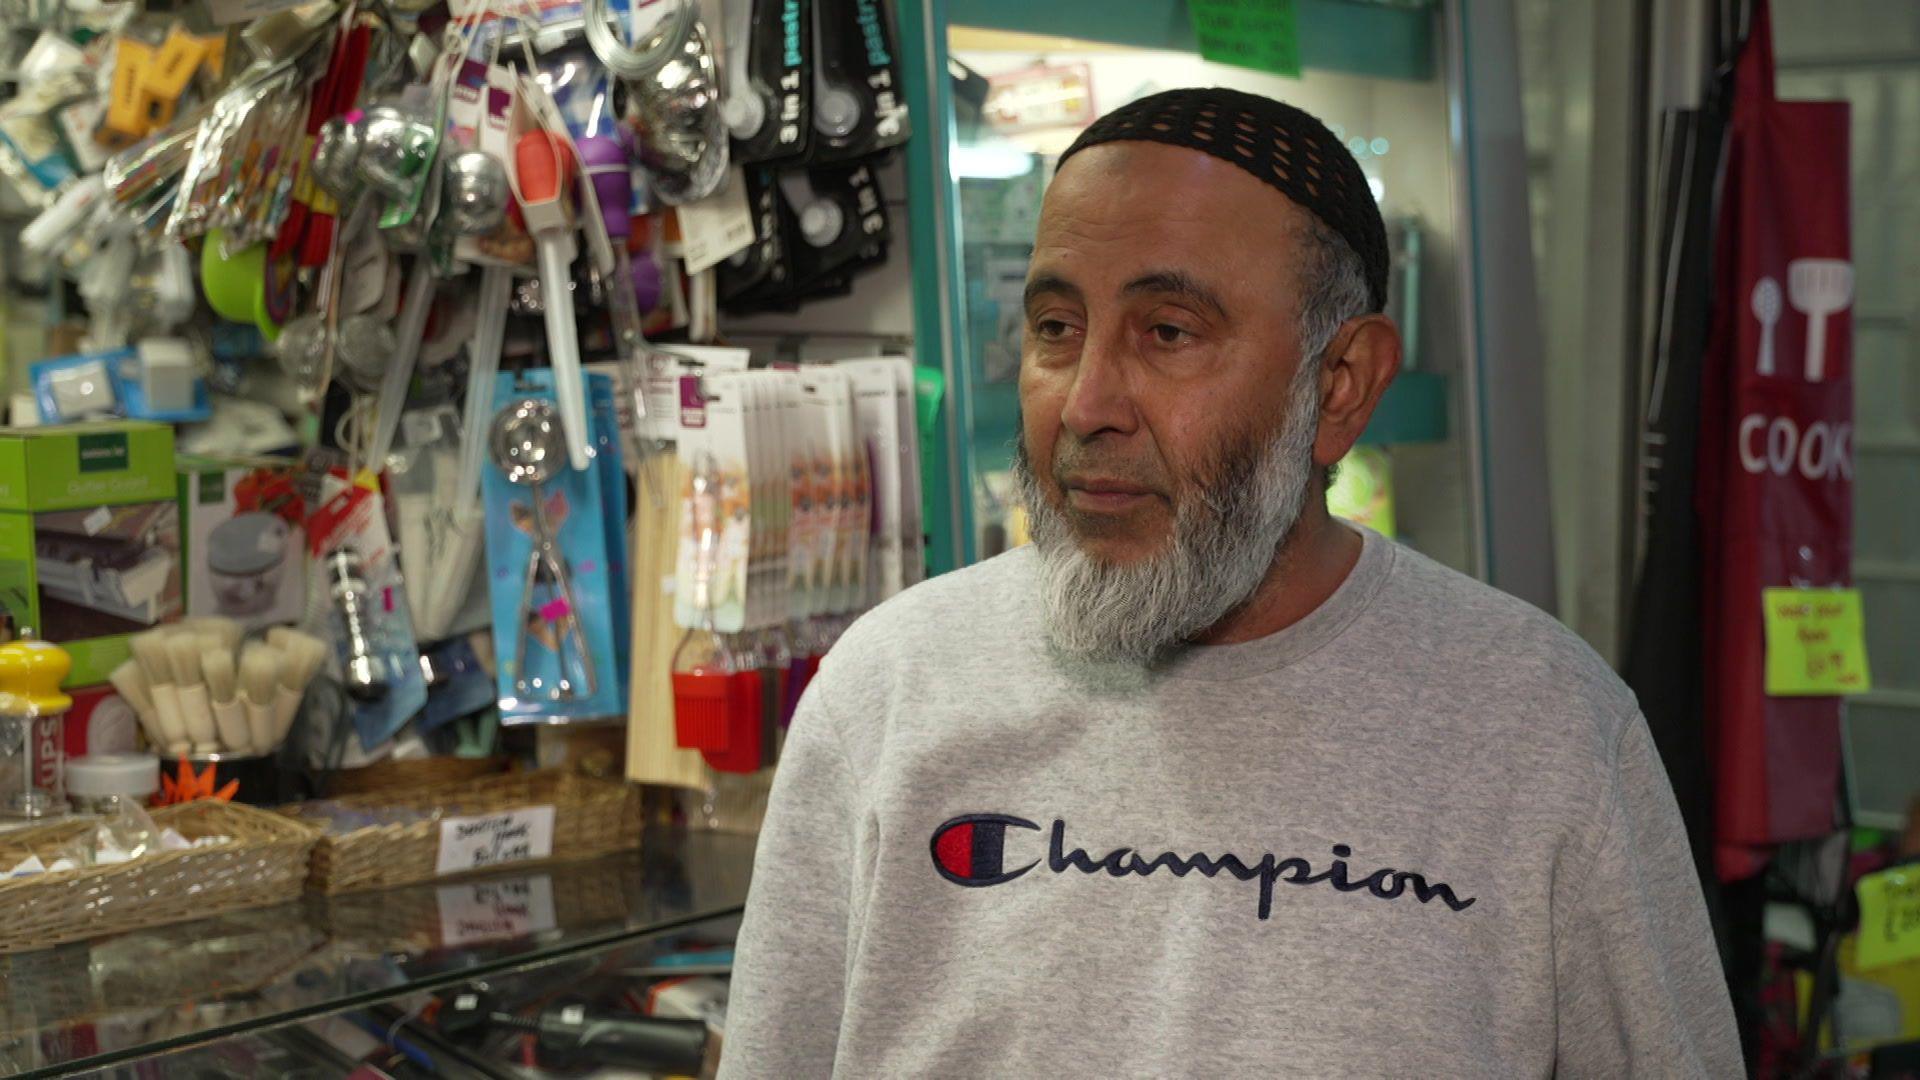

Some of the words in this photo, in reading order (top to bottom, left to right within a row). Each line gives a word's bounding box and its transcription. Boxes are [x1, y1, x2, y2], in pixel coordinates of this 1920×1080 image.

[780, 70, 800, 90] 1
[867, 69, 892, 89] 1
[780, 93, 800, 121] in
[780, 123, 799, 144] 3
[1739, 413, 1853, 481] COOK
[929, 813, 1477, 920] Champion
